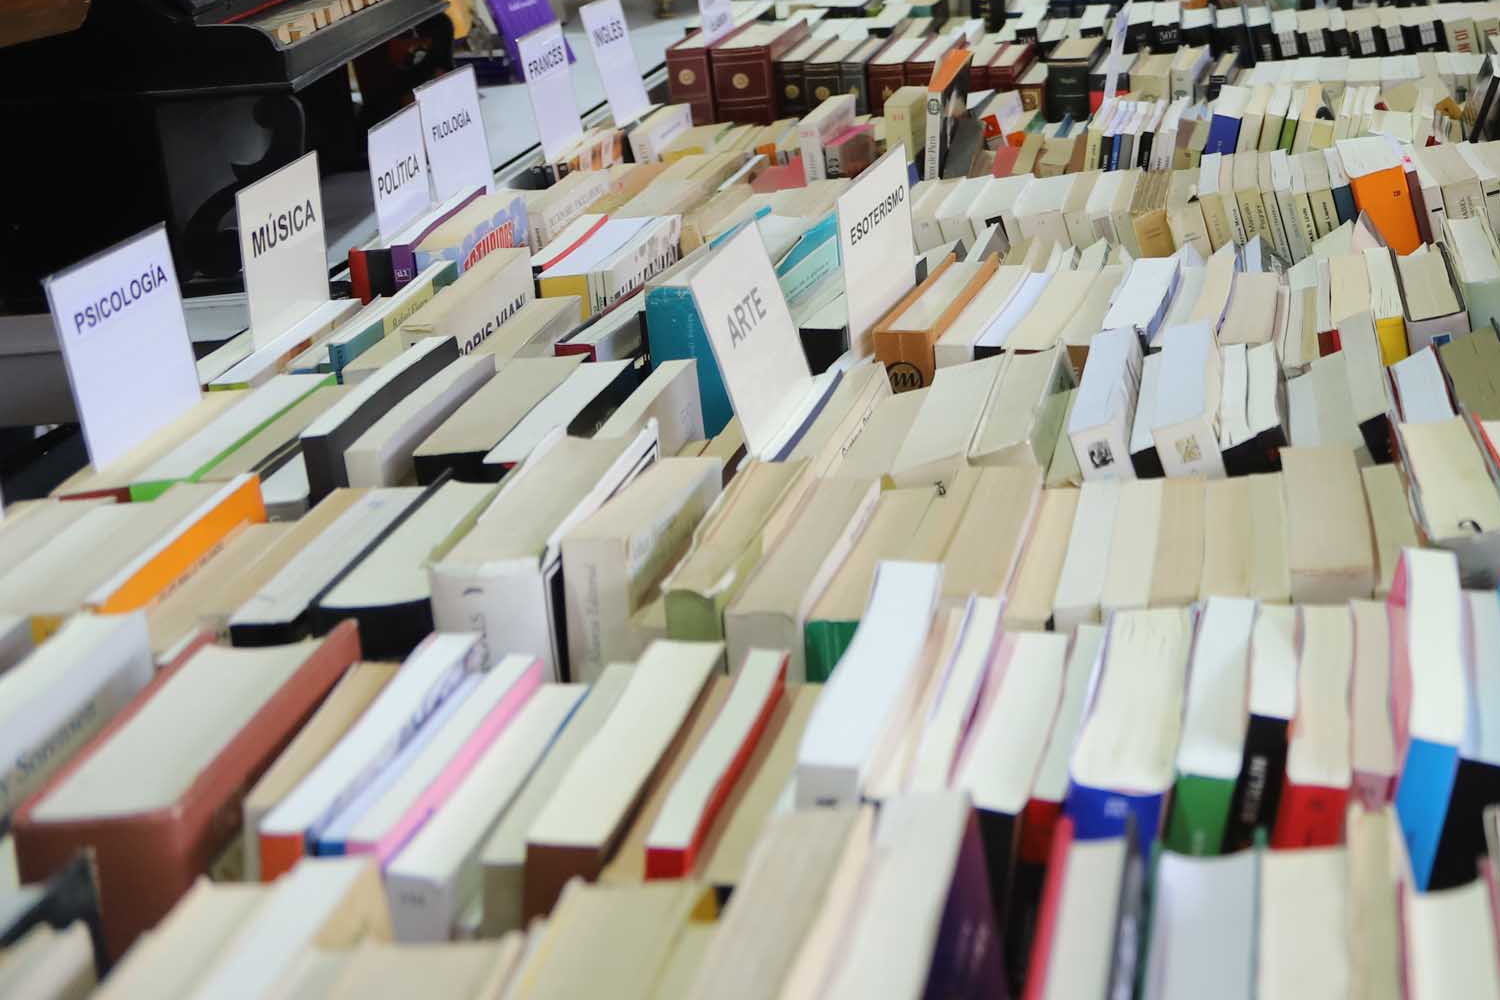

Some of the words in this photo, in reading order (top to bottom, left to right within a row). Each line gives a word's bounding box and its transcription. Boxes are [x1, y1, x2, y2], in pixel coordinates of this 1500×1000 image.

[432, 107, 472, 142] FILOLOGÍA
[377, 152, 421, 200] POLÍTICA
[251, 199, 316, 259] MÚSICA
[850, 184, 905, 246] ESOTERISMO
[74, 263, 168, 335] PSICOLOGÍA
[725, 287, 768, 349] ARTE
